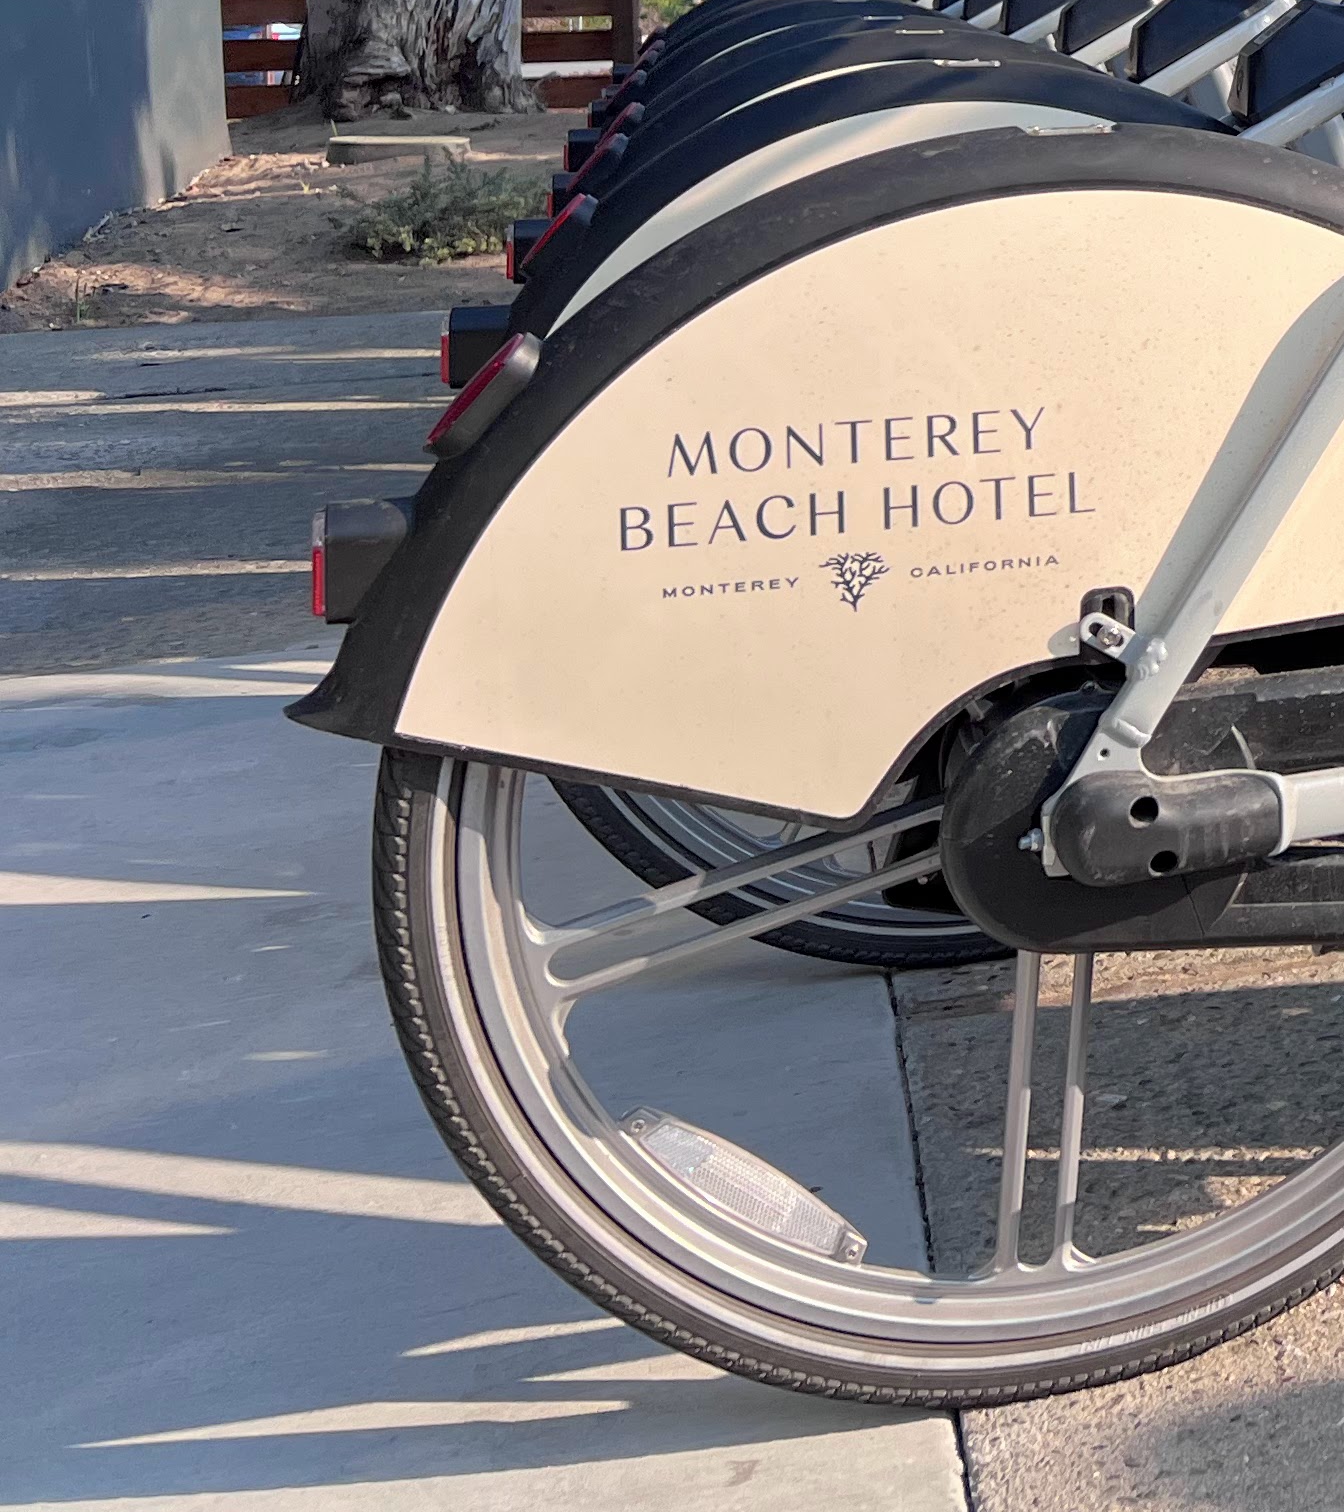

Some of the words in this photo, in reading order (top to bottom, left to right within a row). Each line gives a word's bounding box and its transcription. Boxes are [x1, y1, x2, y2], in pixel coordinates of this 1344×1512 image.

[666, 406, 1046, 478] MONTEREY
[618, 489, 846, 552] BEACH
[882, 471, 1097, 532] HOTEL
[662, 576, 800, 599] MONTEREY
[909, 553, 1060, 579] CALIFORNIA
